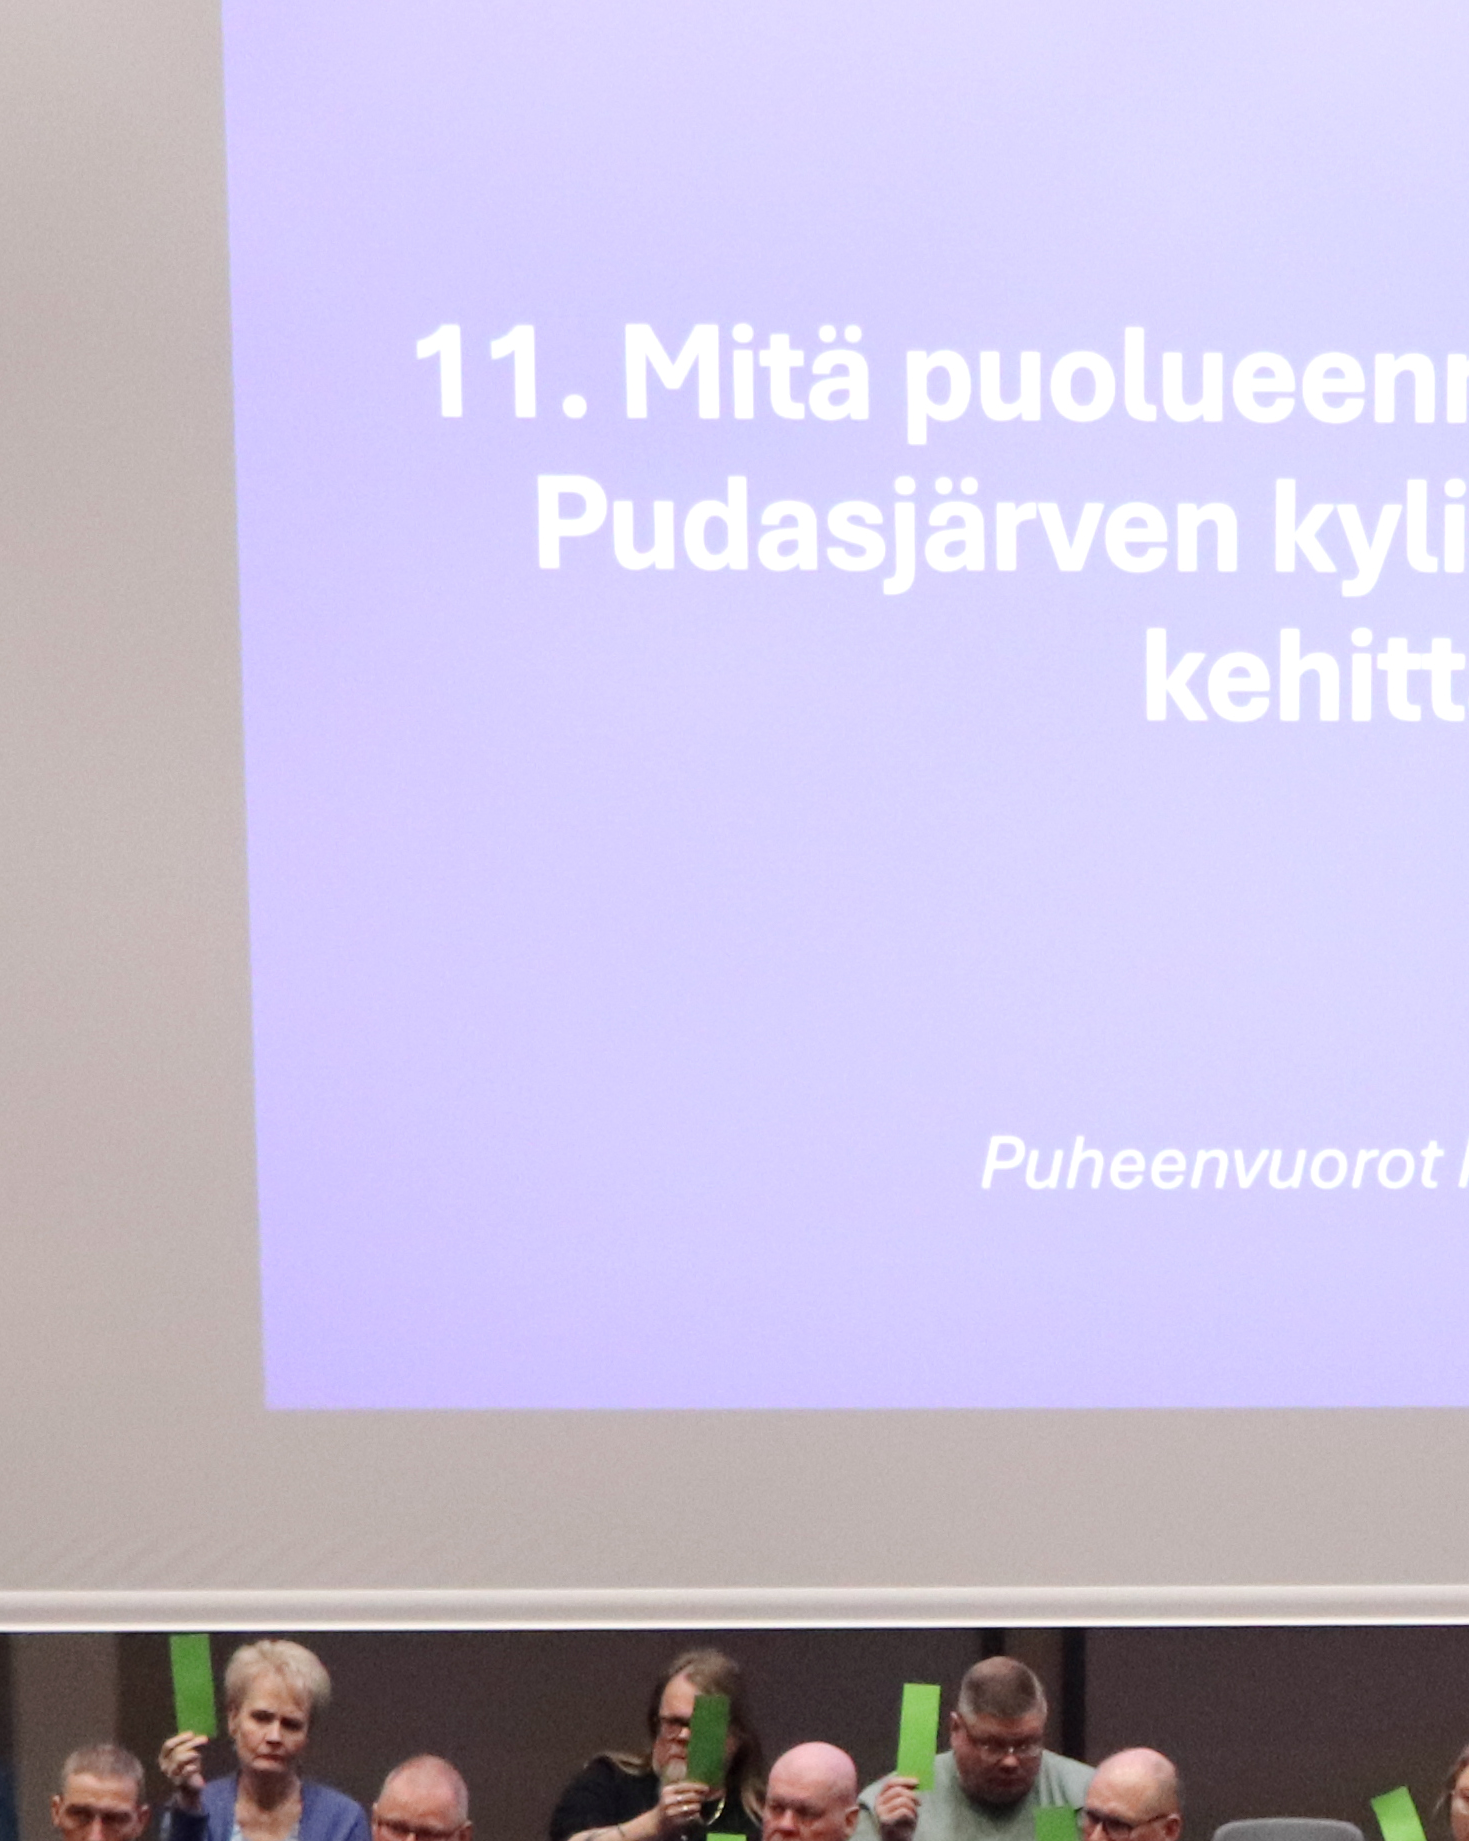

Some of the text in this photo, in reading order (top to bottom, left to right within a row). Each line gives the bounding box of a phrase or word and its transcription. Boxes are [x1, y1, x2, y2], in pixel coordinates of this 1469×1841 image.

[416, 322, 587, 420] 11.
[625, 322, 869, 421] Mitä
[537, 474, 1238, 596] Pudasjärven
[980, 1135, 1446, 1190] Puheenvuorot
